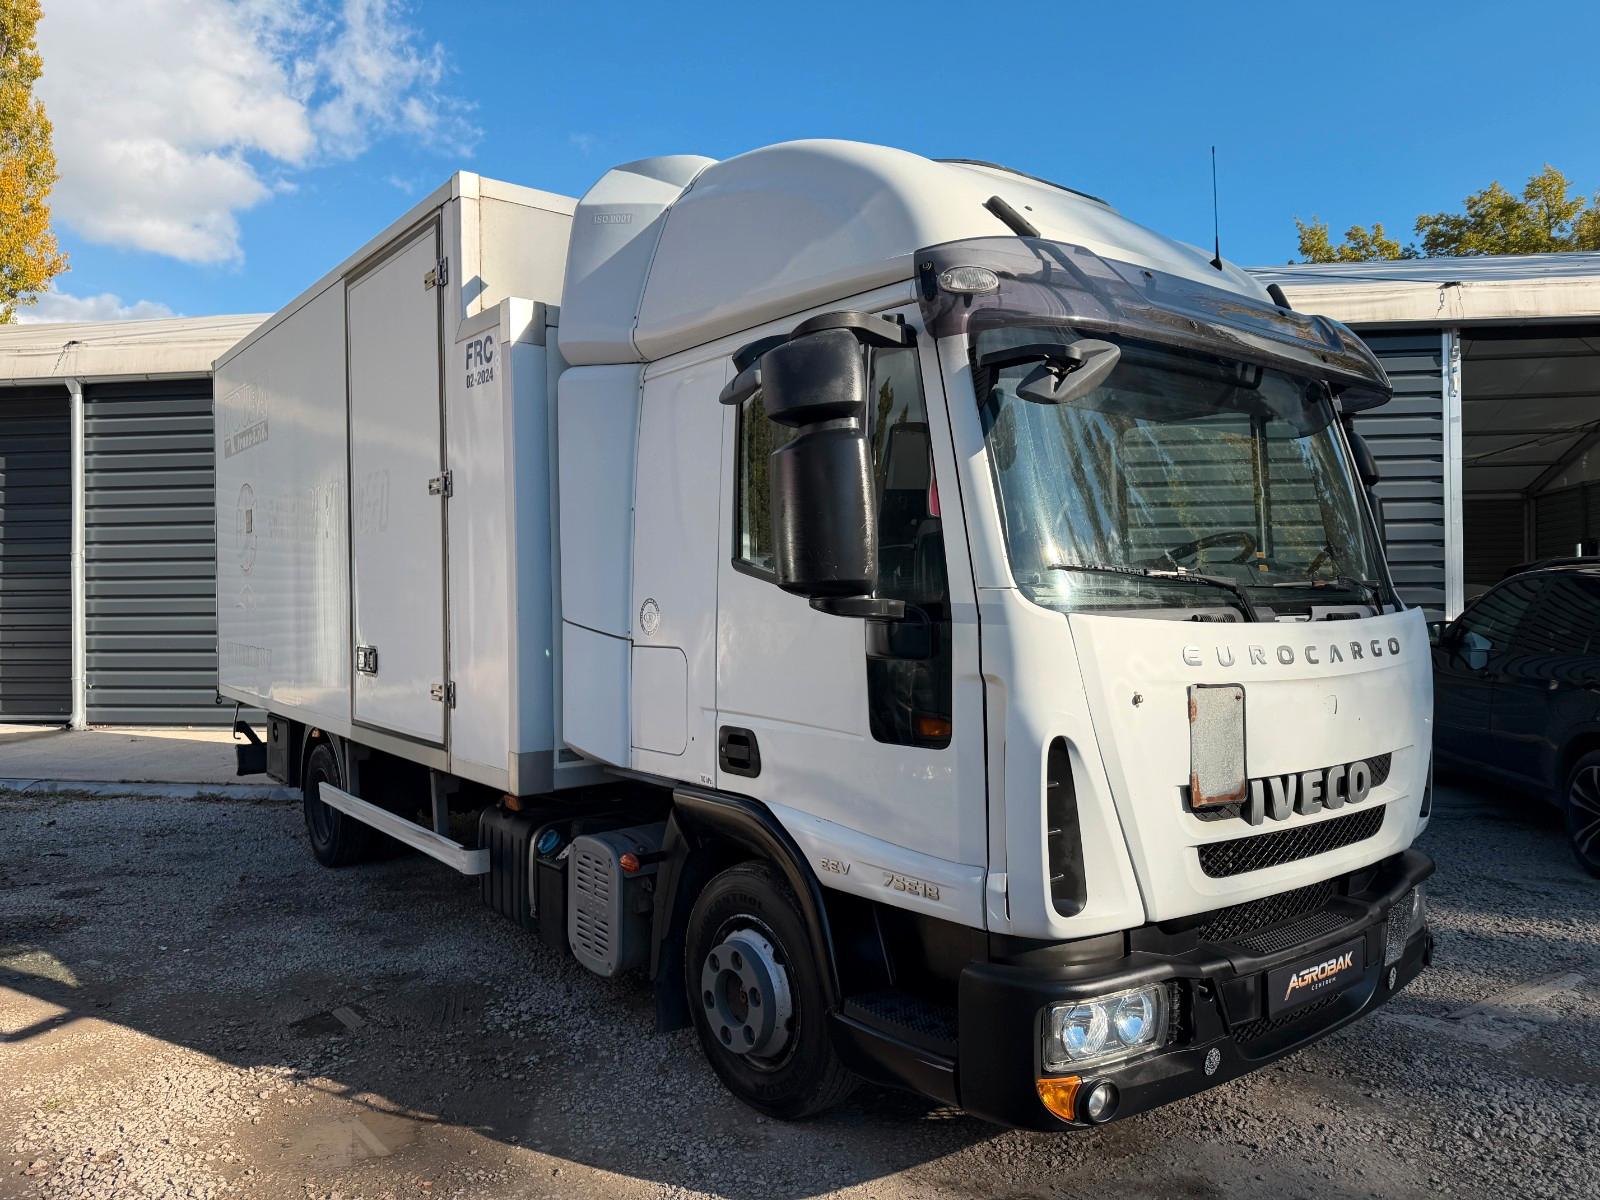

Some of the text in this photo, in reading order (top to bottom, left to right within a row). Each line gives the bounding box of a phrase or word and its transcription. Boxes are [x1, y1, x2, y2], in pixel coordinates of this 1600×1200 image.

[466, 335, 493, 370] FRC
[466, 367, 494, 389] 02-2024
[1182, 636, 1402, 668] EUROCARGO
[1249, 761, 1372, 827] IVECO
[819, 857, 851, 875] EEV
[1284, 951, 1353, 1001] AGROBAK
[1311, 977, 1337, 991] CENTRUM
